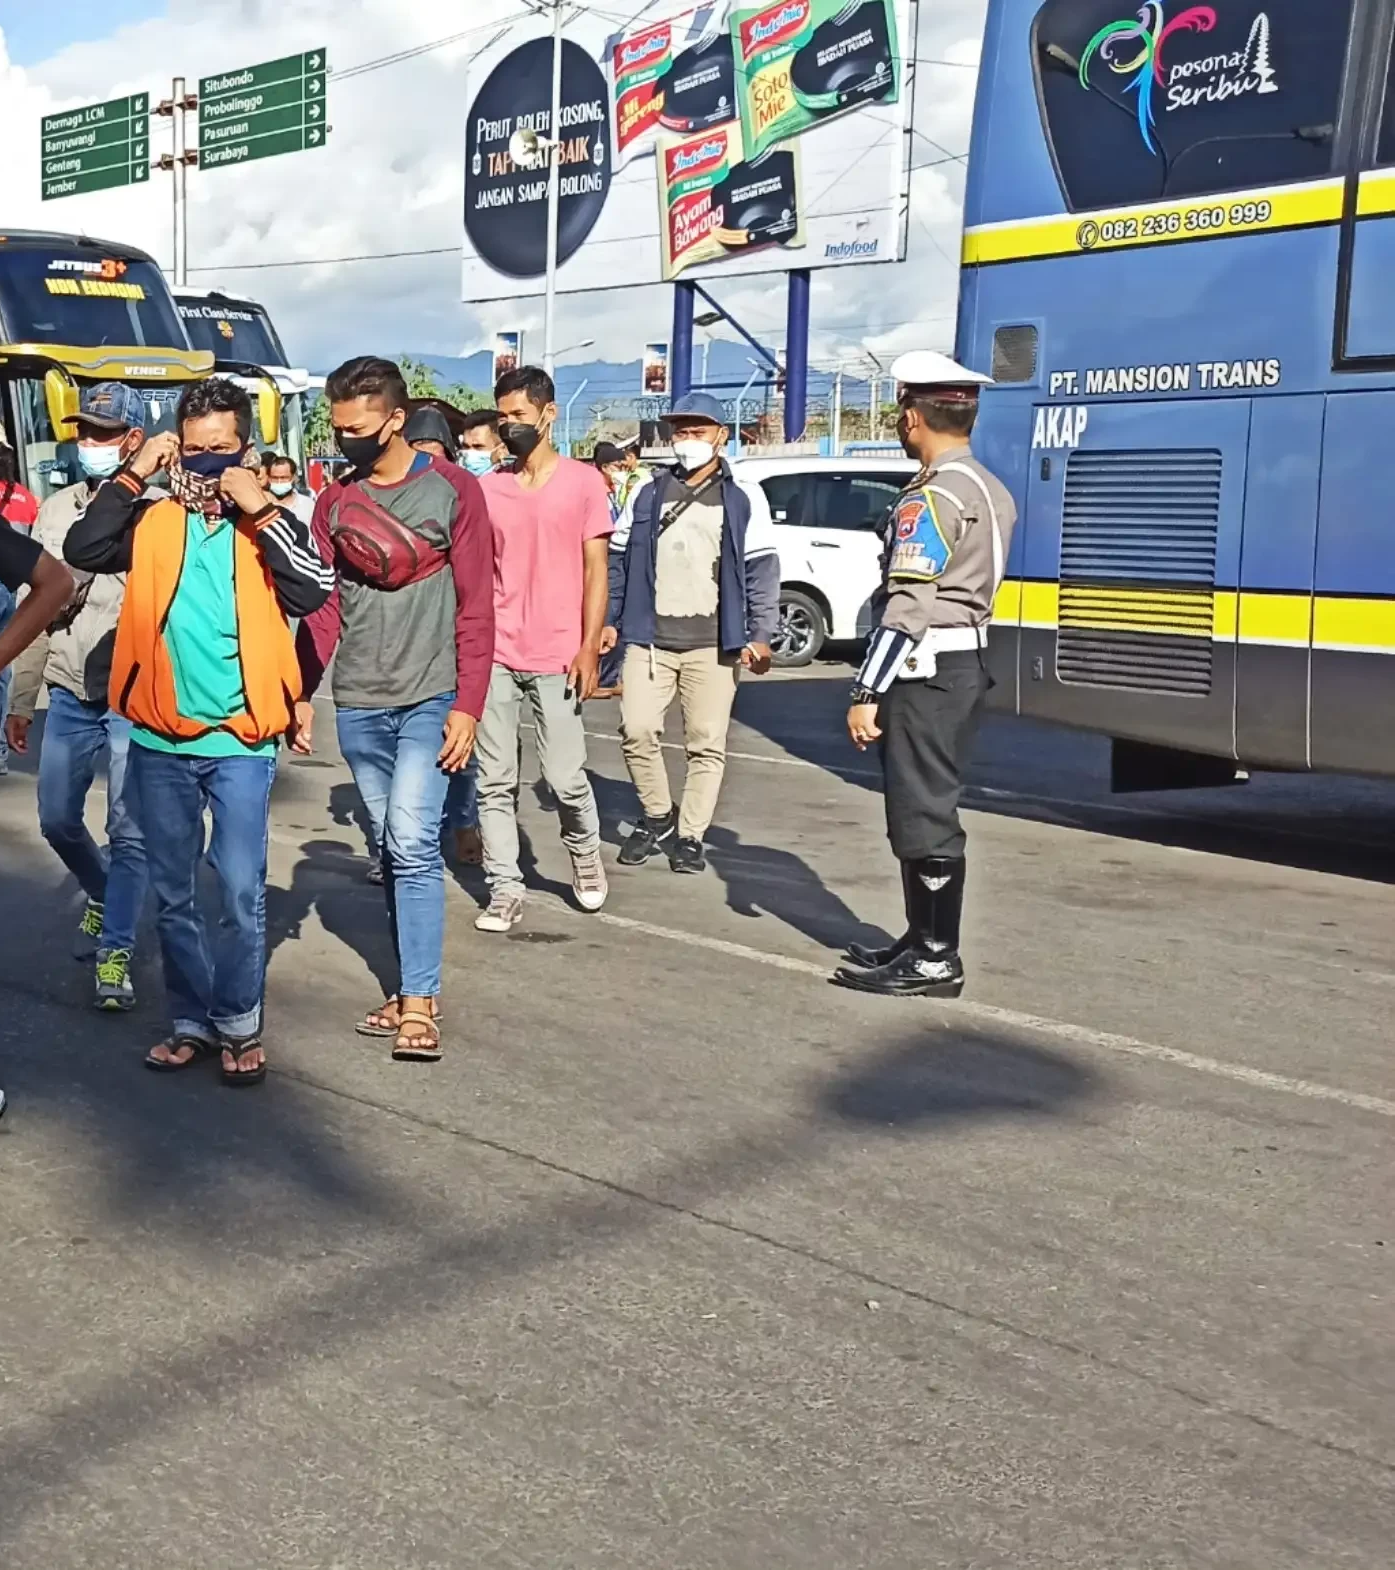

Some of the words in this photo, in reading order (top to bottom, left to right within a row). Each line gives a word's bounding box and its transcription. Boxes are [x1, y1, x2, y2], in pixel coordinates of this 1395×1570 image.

[204, 70, 253, 92] Situbondo
[754, 72, 788, 111] Soto
[1166, 73, 1259, 111] Seribu
[204, 94, 264, 117] Probolinggo
[759, 94, 786, 128] Mie
[45, 114, 83, 132] Dermaga
[86, 106, 105, 121] LCM
[204, 121, 249, 141] Pasuruan
[476, 118, 512, 144] PERUT
[45, 130, 96, 152] Banyuwangi
[204, 145, 249, 163] Surabaya
[46, 158, 81, 175] Genteng
[46, 179, 77, 195] Jember
[475, 186, 514, 209] JANGAN
[518, 181, 552, 203] SAMPA
[560, 172, 603, 196] BOLONG
[674, 195, 712, 234] Ayam
[1101, 219, 1137, 241] 082
[1144, 213, 1178, 236] 236
[1185, 208, 1224, 231] 360
[1229, 201, 1271, 225] 999
[675, 204, 724, 252] Bawang
[824, 238, 879, 258] Indofood
[1049, 370, 1079, 396] PT.
[1085, 364, 1191, 395] MANSION
[1196, 358, 1281, 389] TRANS
[1032, 406, 1088, 449] AKAP
